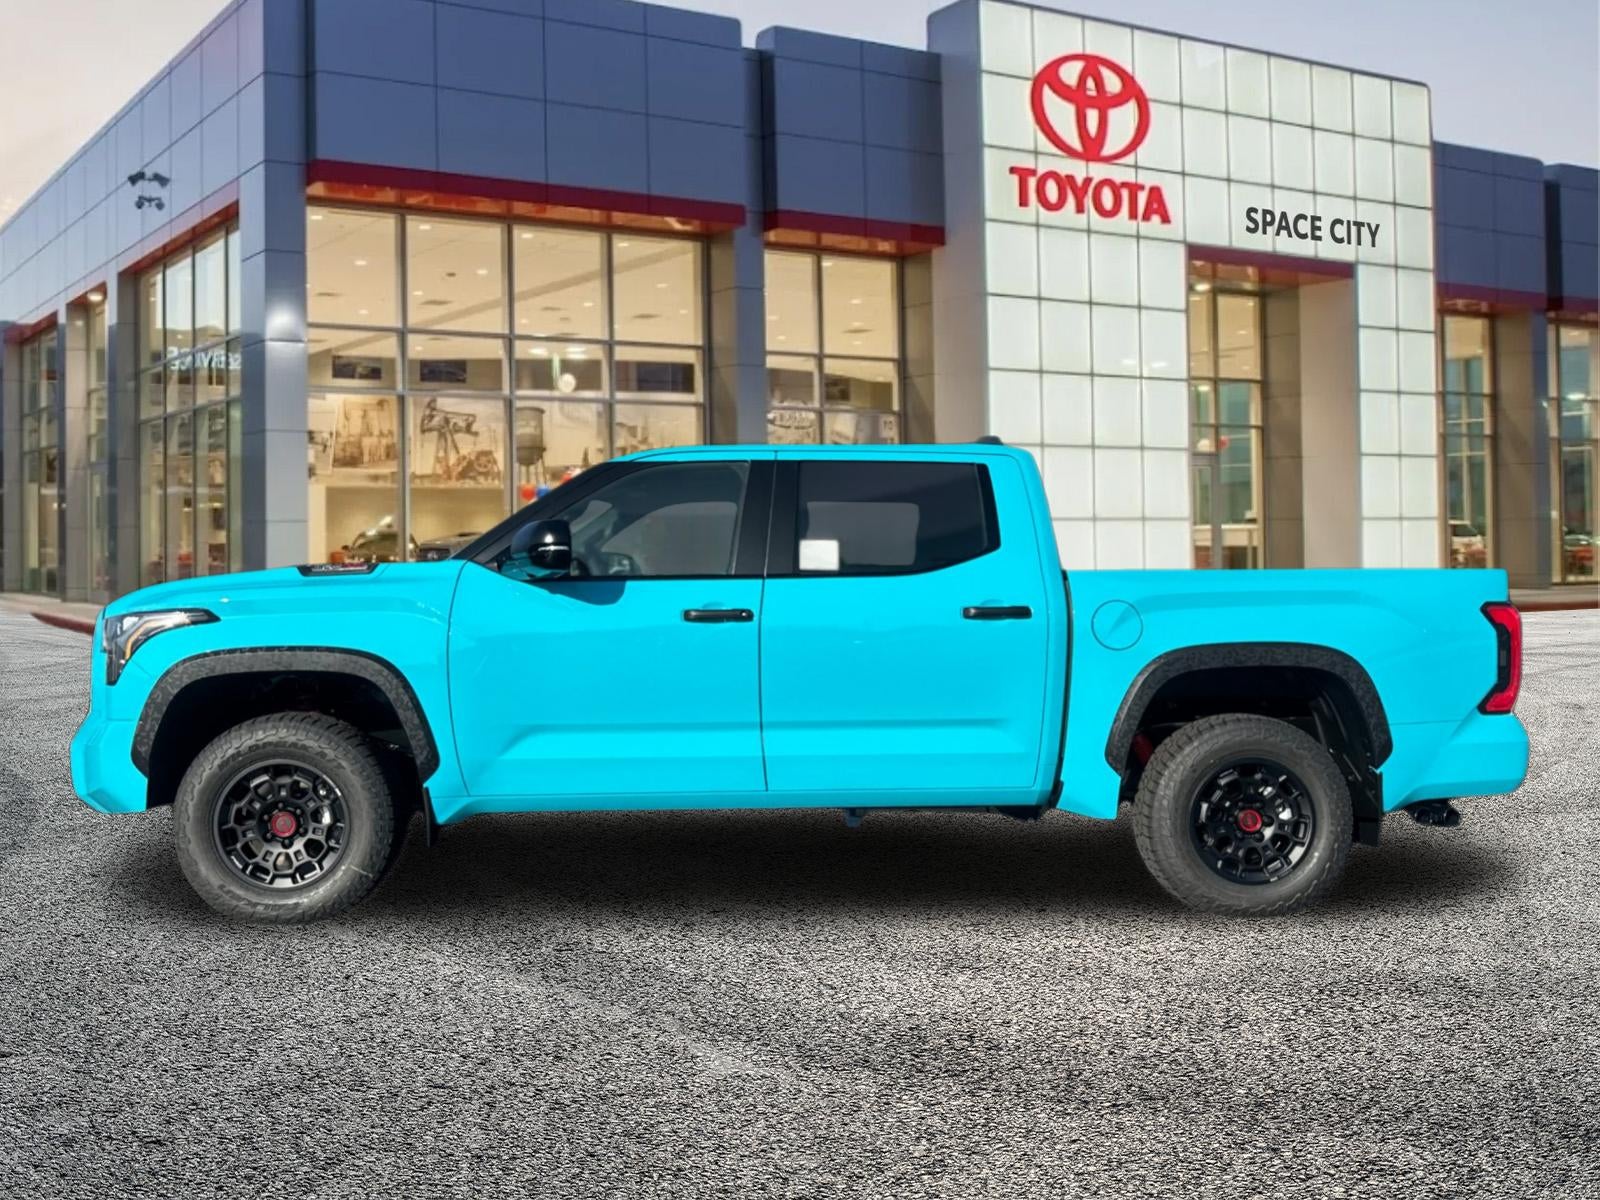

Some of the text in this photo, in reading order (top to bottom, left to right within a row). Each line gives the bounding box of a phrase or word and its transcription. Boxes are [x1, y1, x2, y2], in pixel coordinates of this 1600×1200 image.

[1009, 166, 1171, 224] TOYOTA
[1245, 207, 1380, 248] SPACE CITY
